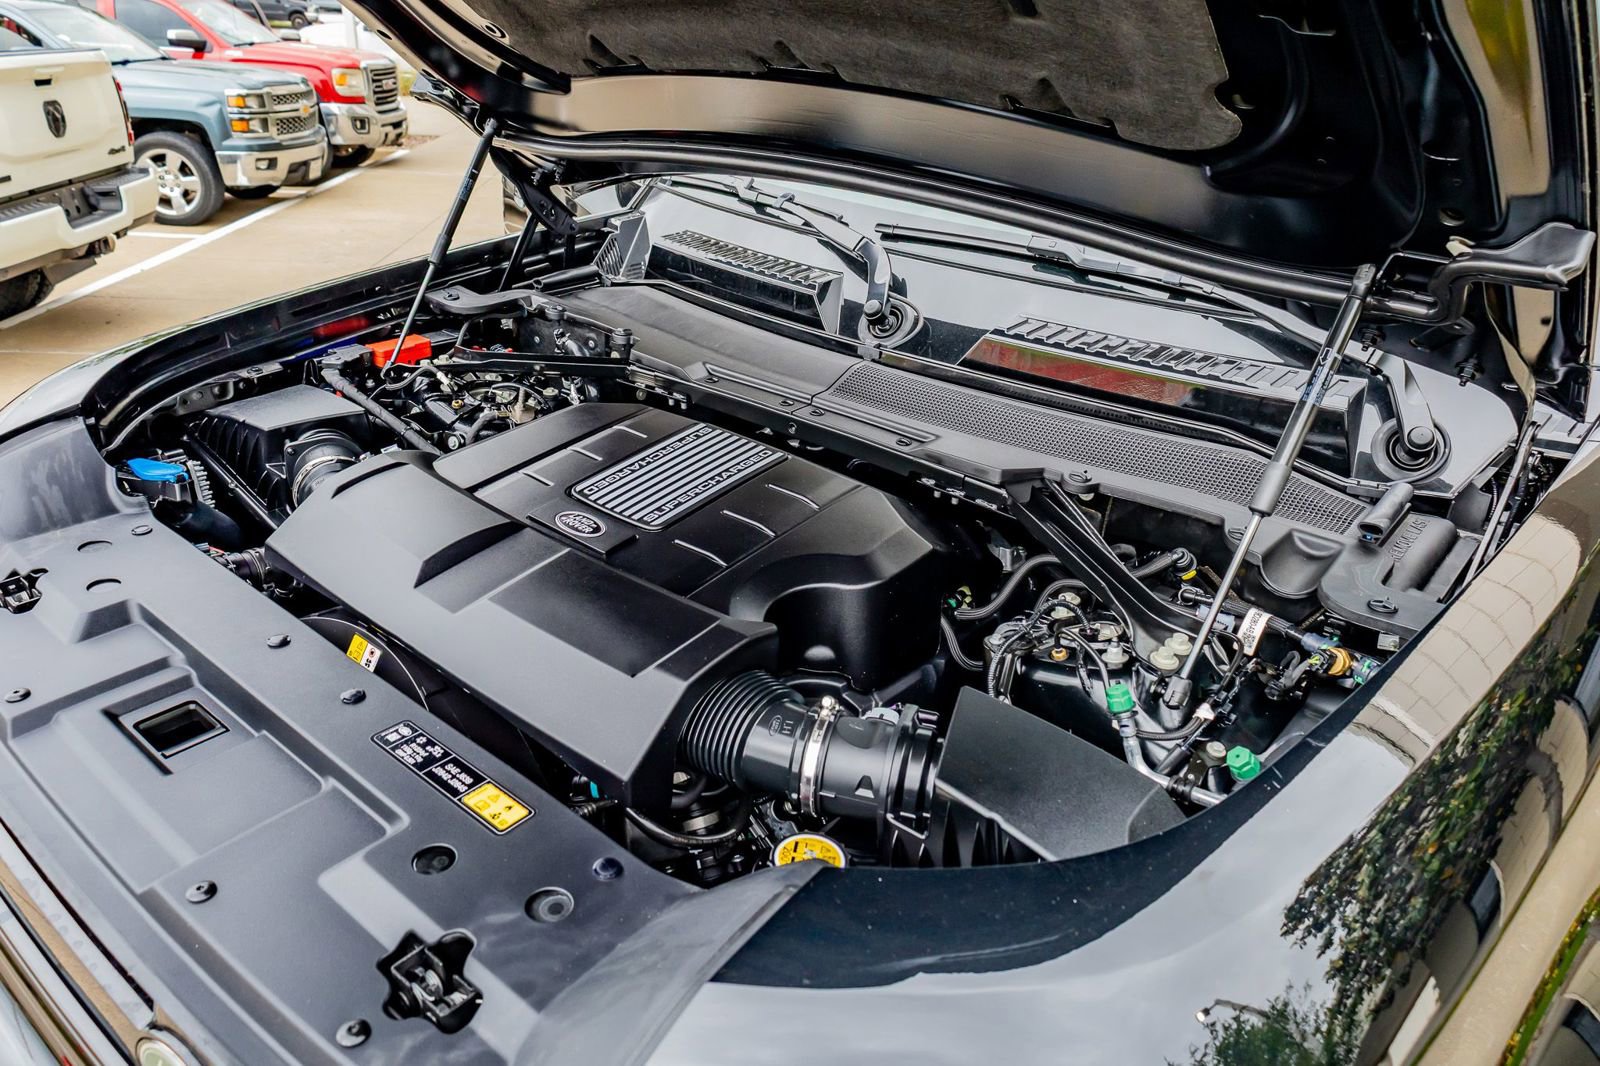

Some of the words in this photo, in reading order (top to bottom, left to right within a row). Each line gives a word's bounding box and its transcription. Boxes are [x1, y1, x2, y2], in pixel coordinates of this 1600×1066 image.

[583, 427, 713, 495] SUPERCHARGED
[643, 449, 773, 522] SUPERCHARGED
[562, 517, 594, 534] ROVER
[568, 512, 595, 526] LAND
[445, 763, 461, 776] SAE
